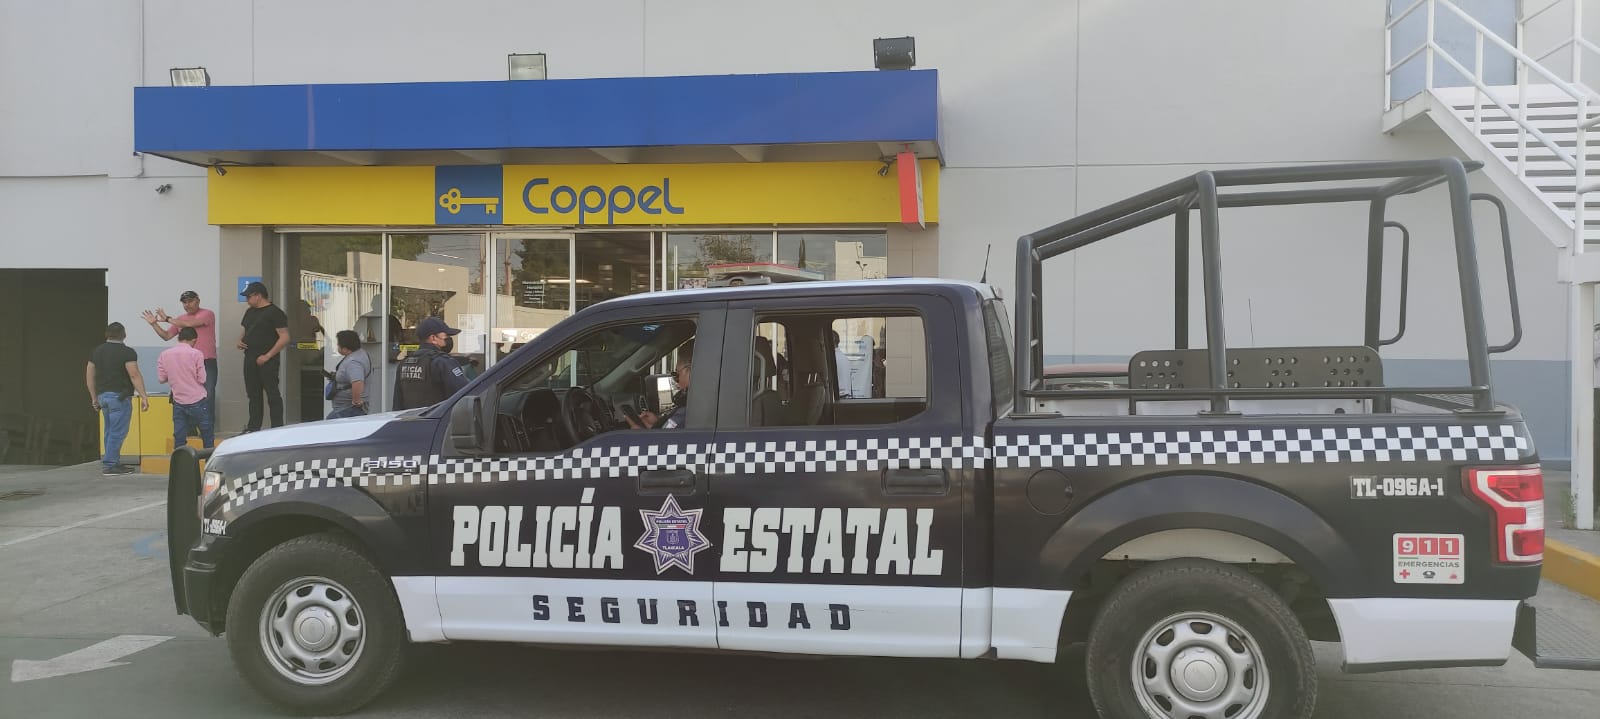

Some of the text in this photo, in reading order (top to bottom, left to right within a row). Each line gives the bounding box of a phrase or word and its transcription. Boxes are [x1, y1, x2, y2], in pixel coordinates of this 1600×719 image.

[523, 178, 684, 224] Coppel
[1353, 478, 1444, 497] TL-096A-1
[450, 487, 944, 576] POLICÍA ESTATAL
[1401, 539, 1455, 554] 911
[532, 594, 852, 631] SEGURIDAD
